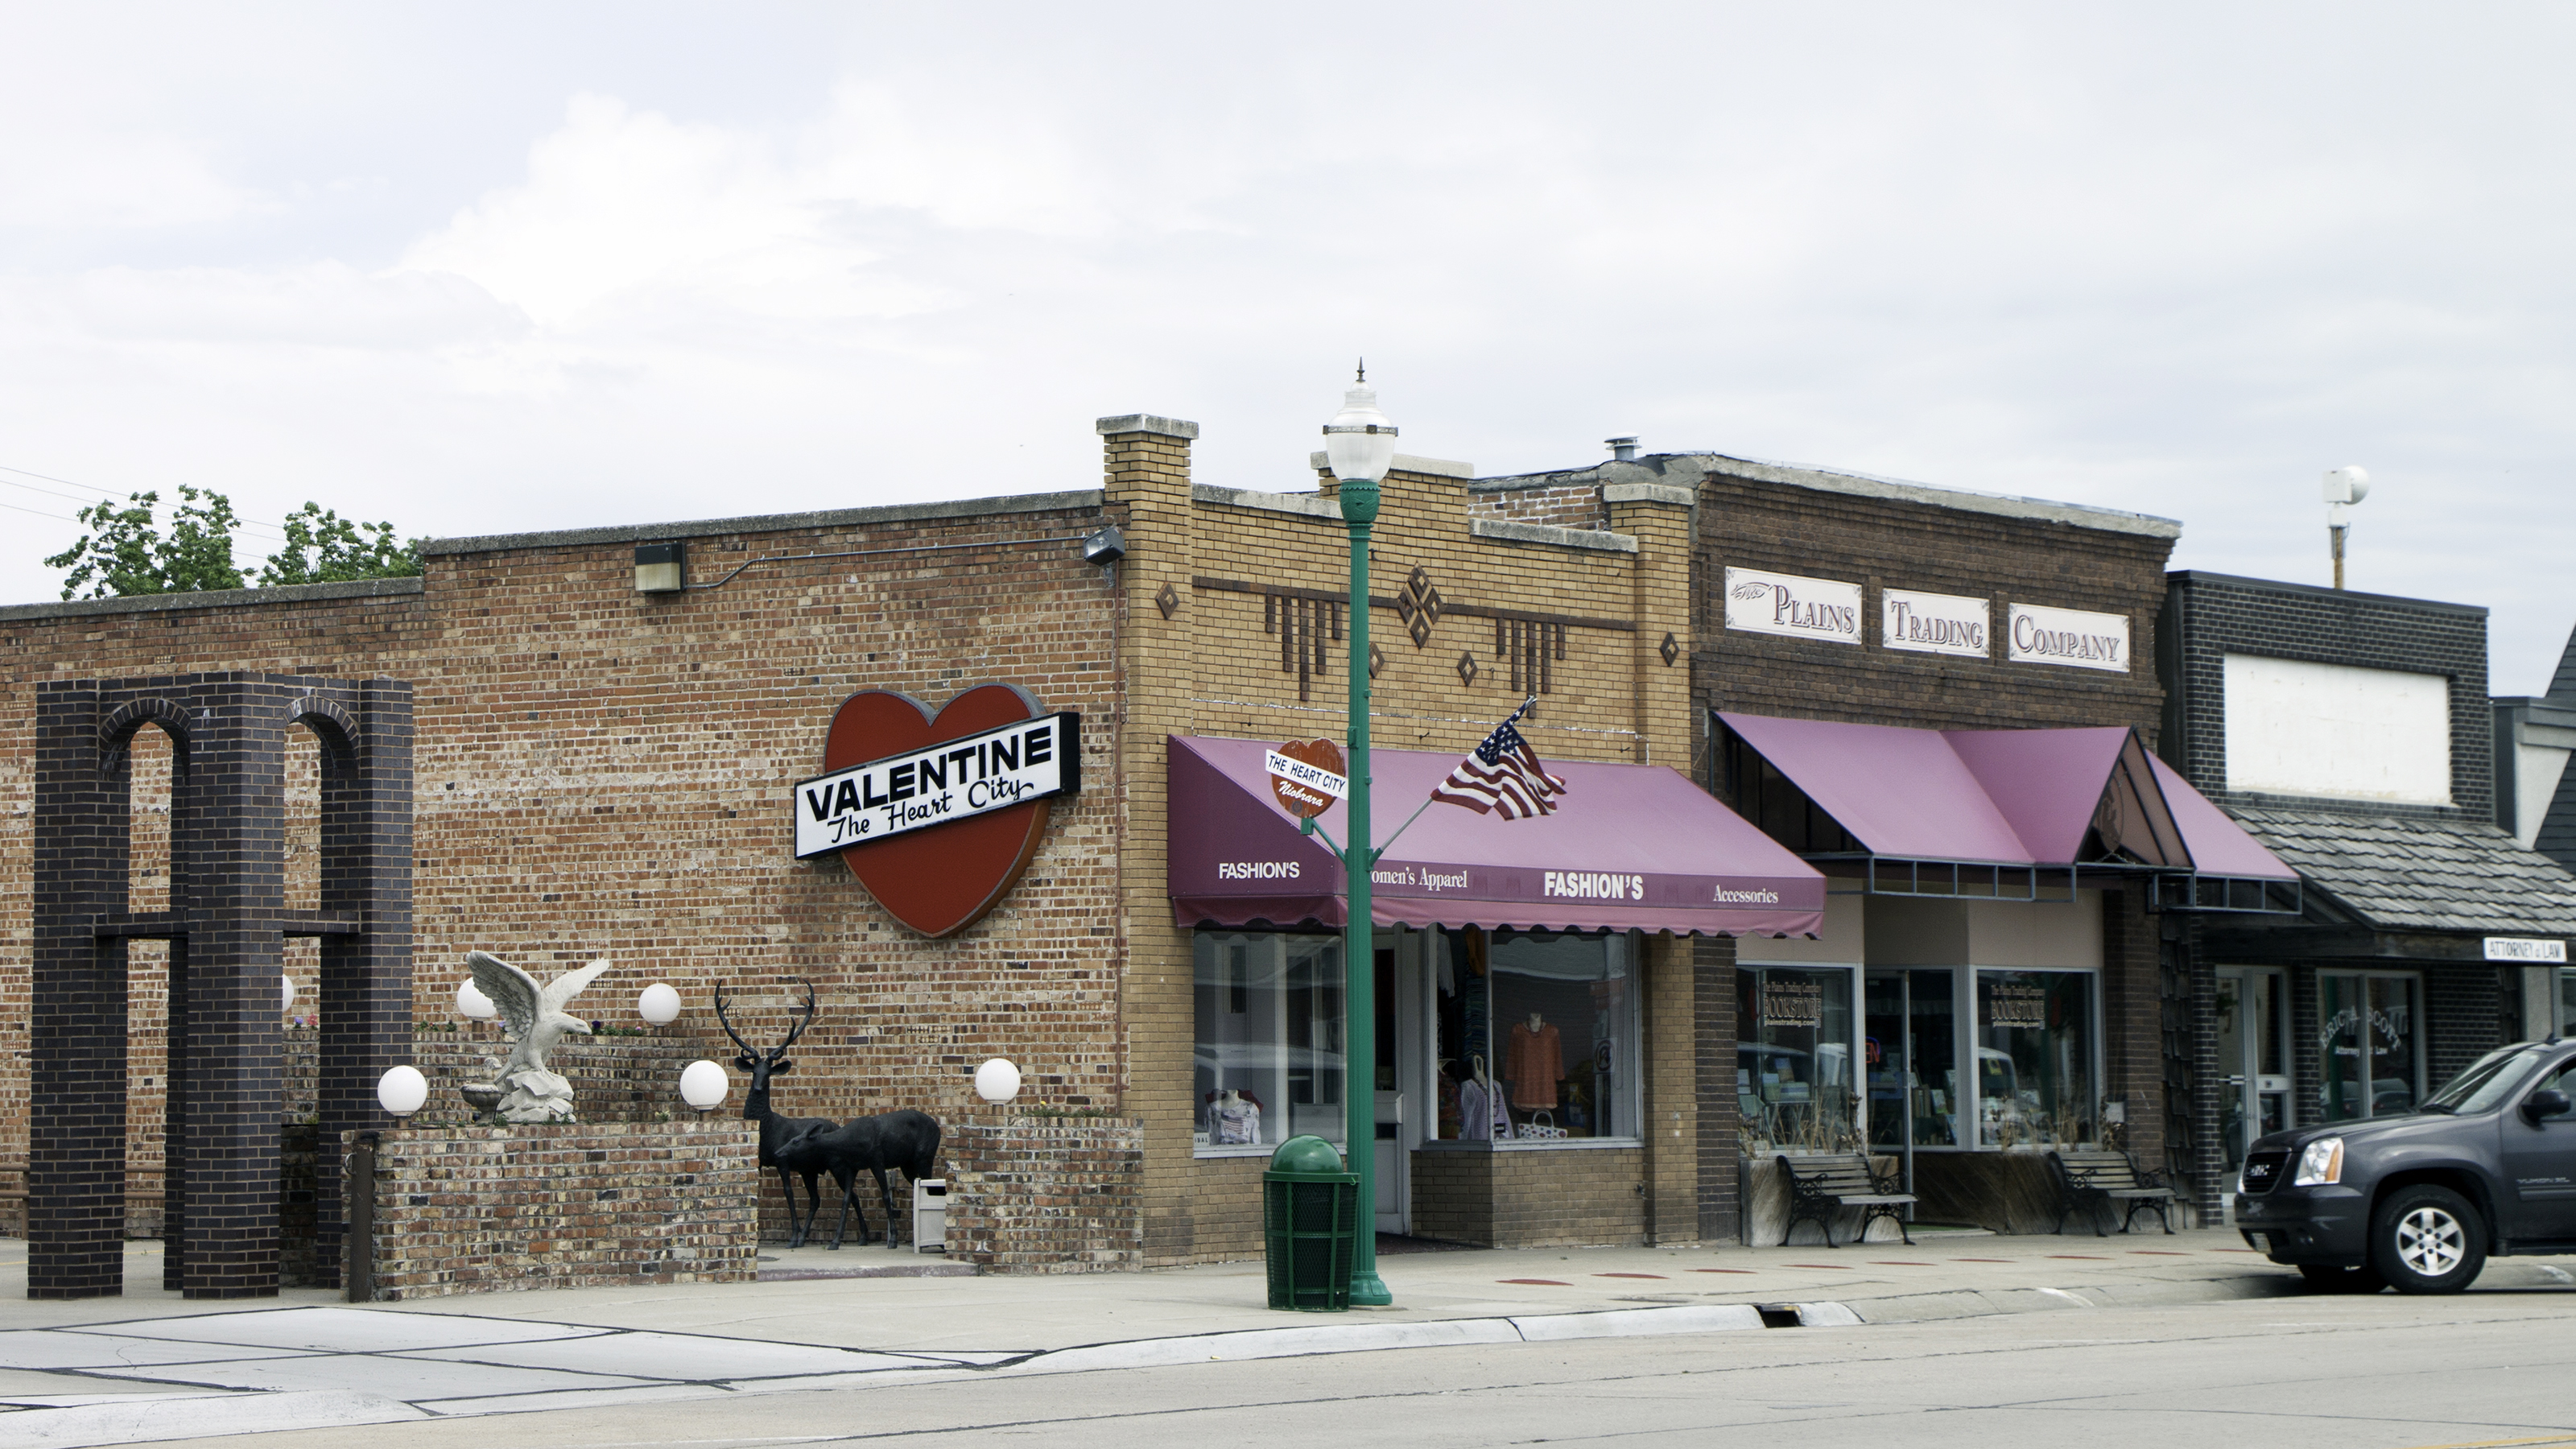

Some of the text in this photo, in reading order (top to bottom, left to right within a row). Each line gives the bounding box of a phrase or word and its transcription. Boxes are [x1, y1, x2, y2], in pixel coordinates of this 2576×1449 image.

[1773, 584, 1855, 634] PLAINS
[1891, 601, 1984, 649] TRADING
[2014, 614, 2120, 662] COMPANY
[806, 725, 1051, 822] VALENTINE
[1269, 754, 1346, 793] THE HEART CITY
[827, 778, 1034, 844] The Heart City
[1278, 780, 1323, 807] Niobrara
[1219, 861, 1468, 891] FASHION'S omen's Apparel
[1544, 872, 1779, 904] FASHION'S Accessories
[2490, 941, 2533, 957] ATTORNEY
[2543, 943, 2562, 959] LAW
[1764, 996, 1822, 1018] BOOKSTORE
[1991, 999, 2045, 1020] BOOKSTORE
